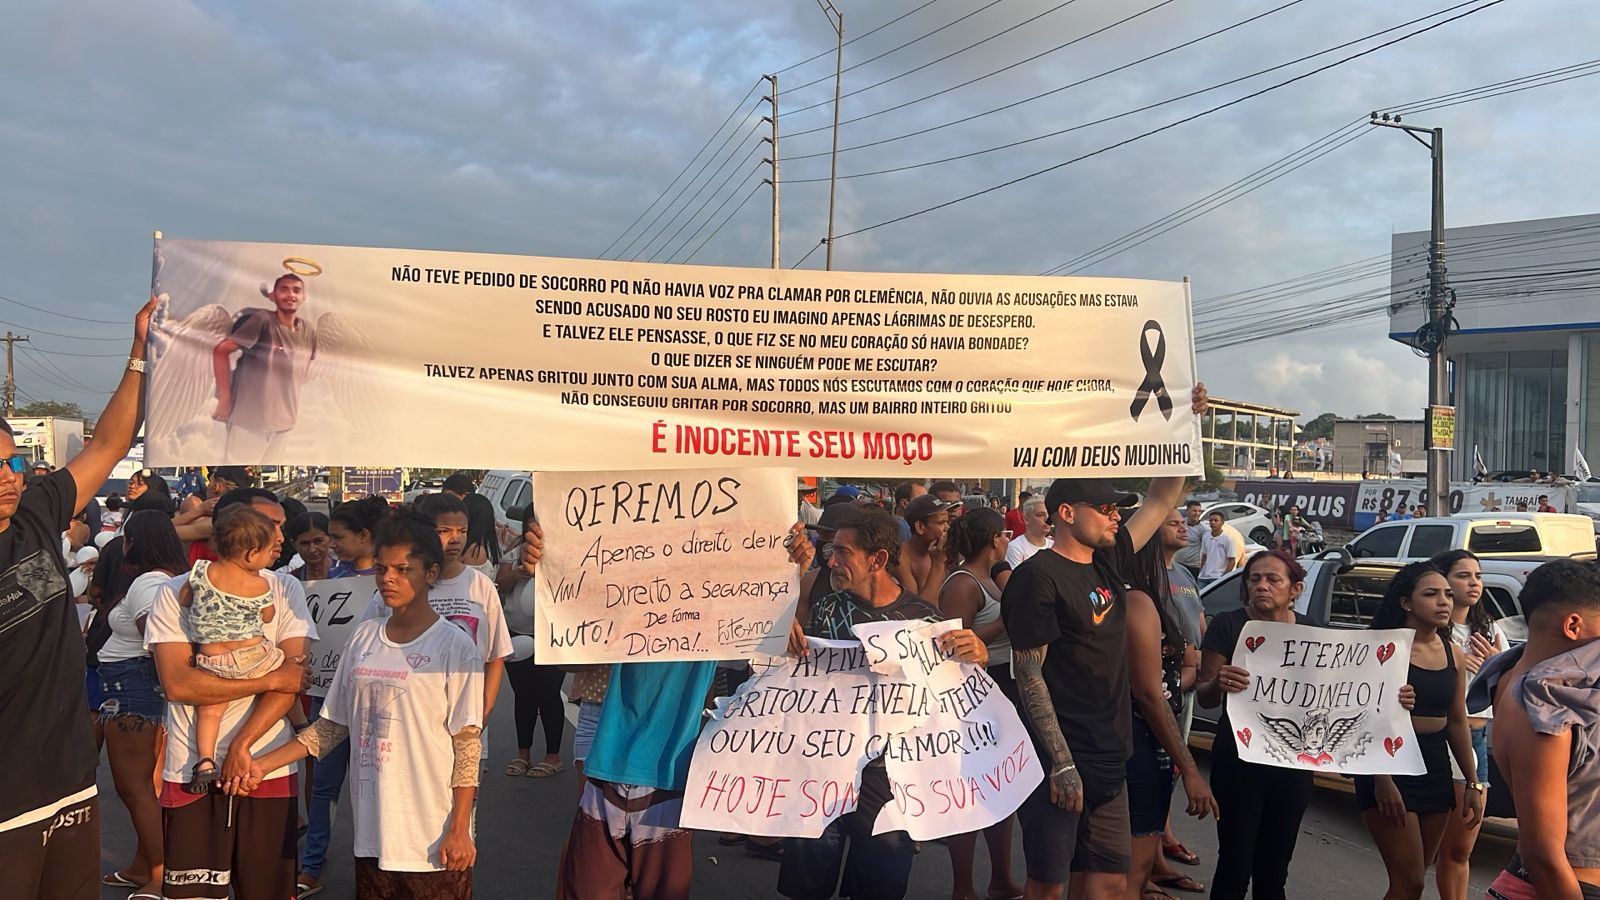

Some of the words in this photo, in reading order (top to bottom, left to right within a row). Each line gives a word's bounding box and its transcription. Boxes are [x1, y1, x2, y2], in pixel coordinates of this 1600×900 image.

[392, 265, 420, 282] NÃO
[425, 268, 460, 284] TEVE
[464, 271, 515, 288] PEDIDO
[520, 274, 537, 288] DE
[542, 275, 606, 293] SOCORRO
[610, 279, 628, 294] PQ
[633, 278, 660, 296] NÃO
[665, 282, 704, 298] HAVIA
[709, 284, 734, 298] VOZ
[738, 286, 764, 300] PRA
[768, 286, 821, 302] CLAMAR
[826, 288, 850, 302] POR
[854, 288, 928, 306] CLEMÊNCIA,
[932, 289, 954, 306] NÃO
[959, 292, 992, 306] OUVIA
[996, 292, 1010, 306] AS
[1014, 291, 1076, 309] ACUSAÇÕES
[1080, 294, 1102, 307] MAS
[1104, 294, 1138, 308] ESTAVA
[536, 300, 582, 315] SENDO
[586, 302, 650, 318] ACUSADO
[654, 306, 672, 320] NO
[676, 306, 702, 321] SEU
[706, 308, 748, 323] ROSTO
[753, 310, 770, 324] EU
[773, 310, 827, 325] IMAGINO
[832, 312, 880, 326] APENAS
[884, 311, 946, 328] LÁGRIMAS
[950, 314, 964, 328] DE
[967, 314, 1035, 328] DESESPERO.
[543, 324, 551, 338] E
[556, 325, 604, 340] TALVEZ
[609, 327, 633, 341] ELE
[638, 328, 710, 346] PENSASSE,
[714, 332, 723, 345] O
[727, 332, 752, 346] QUE
[756, 334, 776, 347] FIZ
[780, 334, 795, 348] SE
[800, 334, 816, 348] NO
[821, 335, 846, 348] MEU
[851, 333, 908, 351] CORAÇÃO
[912, 333, 926, 350] SÓ
[931, 336, 965, 350] HAVIA
[969, 336, 1028, 350] BONDADE?
[652, 352, 660, 366] O
[664, 353, 690, 367] QUE
[694, 354, 732, 368] DIZER
[736, 356, 752, 368] SE
[756, 354, 814, 370] NINGUÉM
[818, 357, 850, 370] PODE
[854, 358, 873, 371] ME
[877, 358, 937, 372] ESCUTAR?
[424, 364, 474, 378] TALVEZ
[479, 368, 534, 382] APENAS
[538, 370, 588, 385] GRITOU
[592, 372, 634, 387] JUNTO
[638, 374, 667, 388] COM
[672, 376, 697, 390] SUA
[701, 377, 742, 393] ALMA,
[746, 378, 774, 392] MAS
[779, 378, 819, 392] TODOS
[823, 377, 848, 392] NÓS
[852, 380, 922, 393] ESCUTAMOS
[926, 380, 951, 392] COM
[955, 380, 962, 392] O
[966, 378, 1019, 394] CORAÇÃO
[1022, 380, 1044, 392] QUE
[561, 391, 588, 405] NÃO
[593, 394, 668, 408] CONSEGUIU
[672, 397, 718, 410] GRITAR
[722, 399, 748, 412] POR
[752, 400, 814, 415] SOCORRO,
[818, 402, 846, 414] MAS
[850, 402, 868, 414] UM
[872, 402, 917, 414] BAIRRO
[920, 402, 967, 414] INTEIRO
[970, 401, 1012, 414] GRITOU
[652, 420, 667, 453] É
[676, 425, 800, 457] INOCENTE
[808, 430, 856, 459] SEU
[863, 432, 932, 465] MOÇO
[1013, 448, 1039, 468] VAI
[1042, 446, 1078, 467] COM
[1082, 446, 1120, 466] DEUS
[1124, 443, 1190, 466] MUDINHO
[566, 477, 741, 531] QEREMOS
[1296, 495, 1346, 518] PLUS
[1362, 498, 1377, 511] R$
[581, 536, 655, 574] Apenas
[662, 545, 672, 556] o
[682, 530, 732, 553] direito
[1280, 640, 1369, 668] ETERNO
[850, 683, 930, 716] FAVELA
[802, 730, 856, 759] SEU
[700, 771, 790, 818] HOJE
